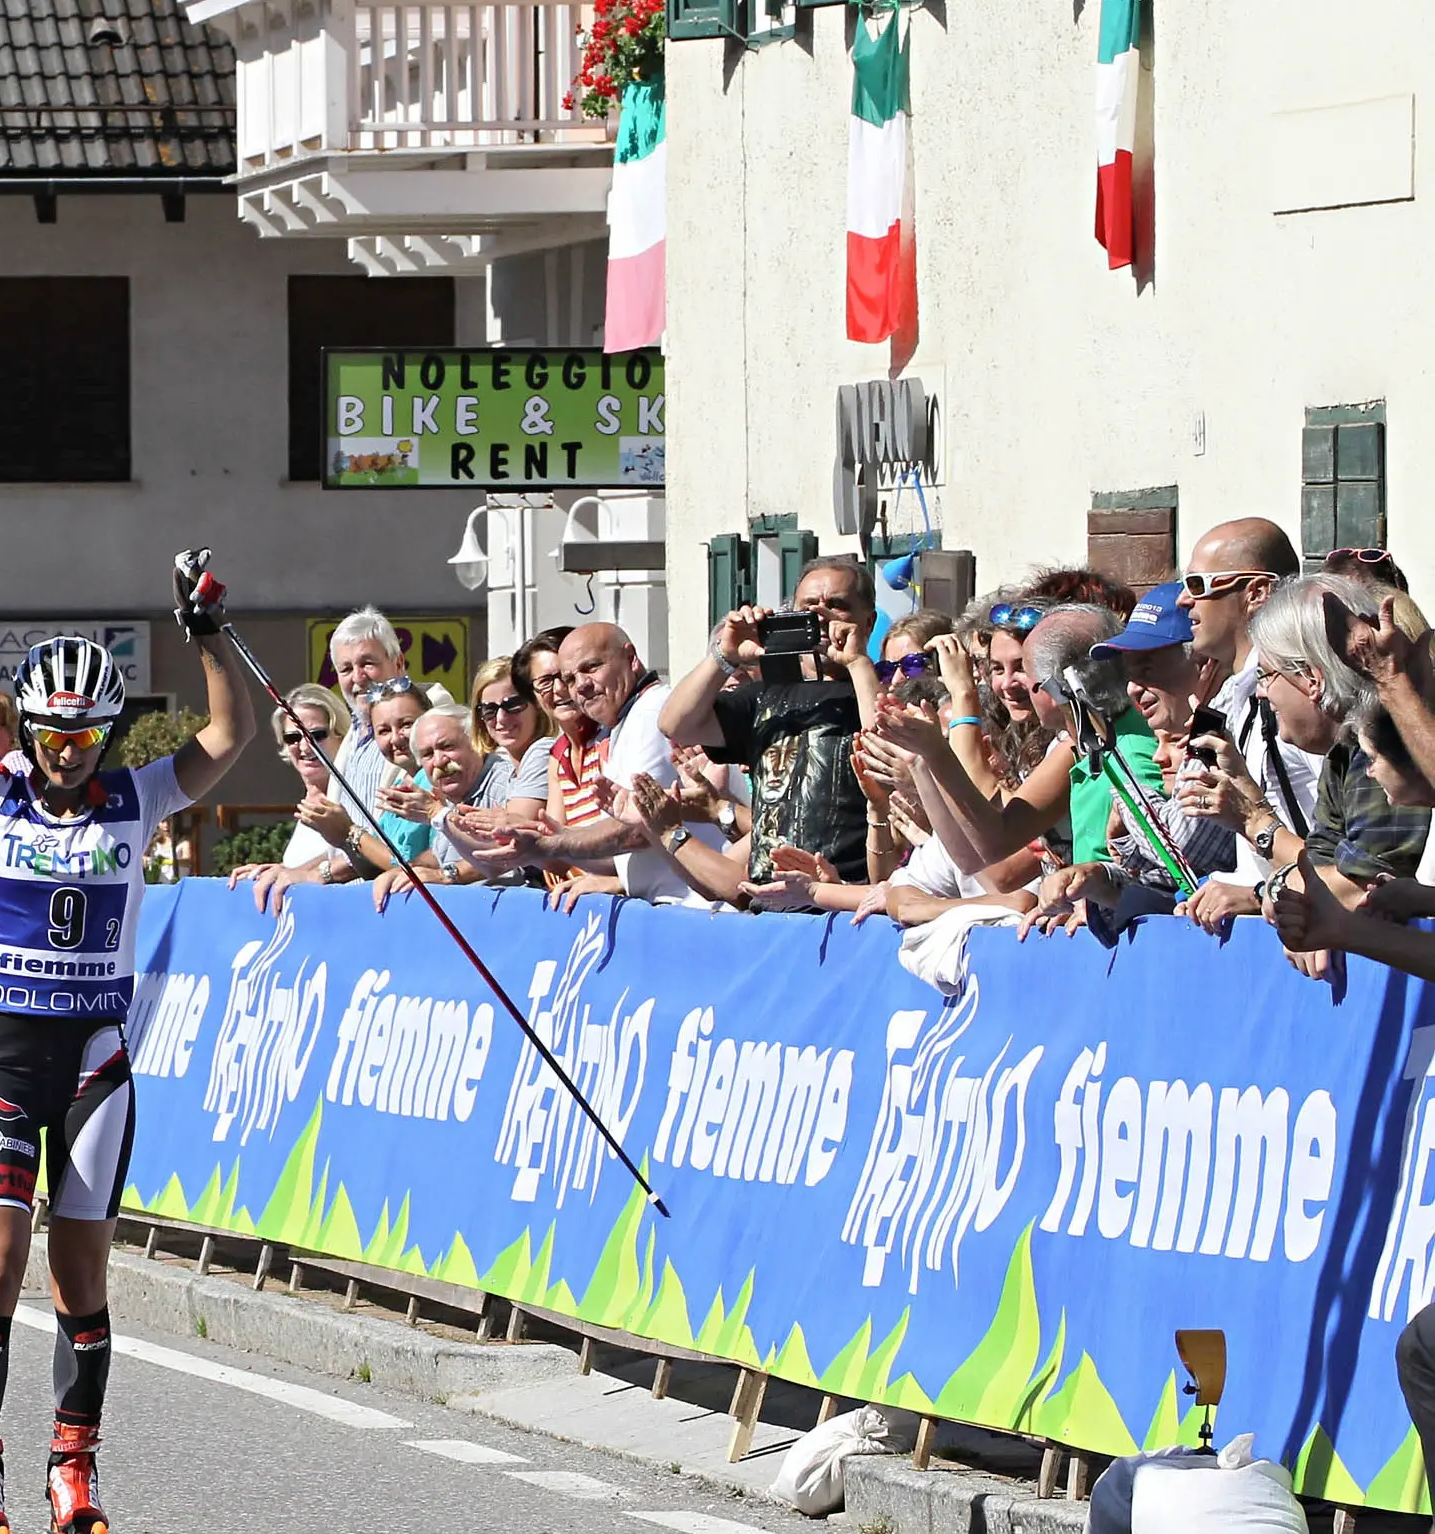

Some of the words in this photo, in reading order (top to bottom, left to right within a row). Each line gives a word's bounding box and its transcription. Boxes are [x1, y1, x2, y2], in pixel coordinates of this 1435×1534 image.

[381, 354, 652, 391] NOLEGGIO
[336, 394, 479, 437] BIKE
[520, 394, 554, 436] &
[594, 394, 665, 437] SK
[451, 442, 583, 481] RENT
[3, 833, 132, 878] TRENTINO
[47, 886, 89, 951] 9
[105, 918, 121, 948] 2
[325, 968, 495, 1123] fiemme
[652, 1005, 856, 1187] fiemme
[1038, 1041, 1337, 1263] fiemme
